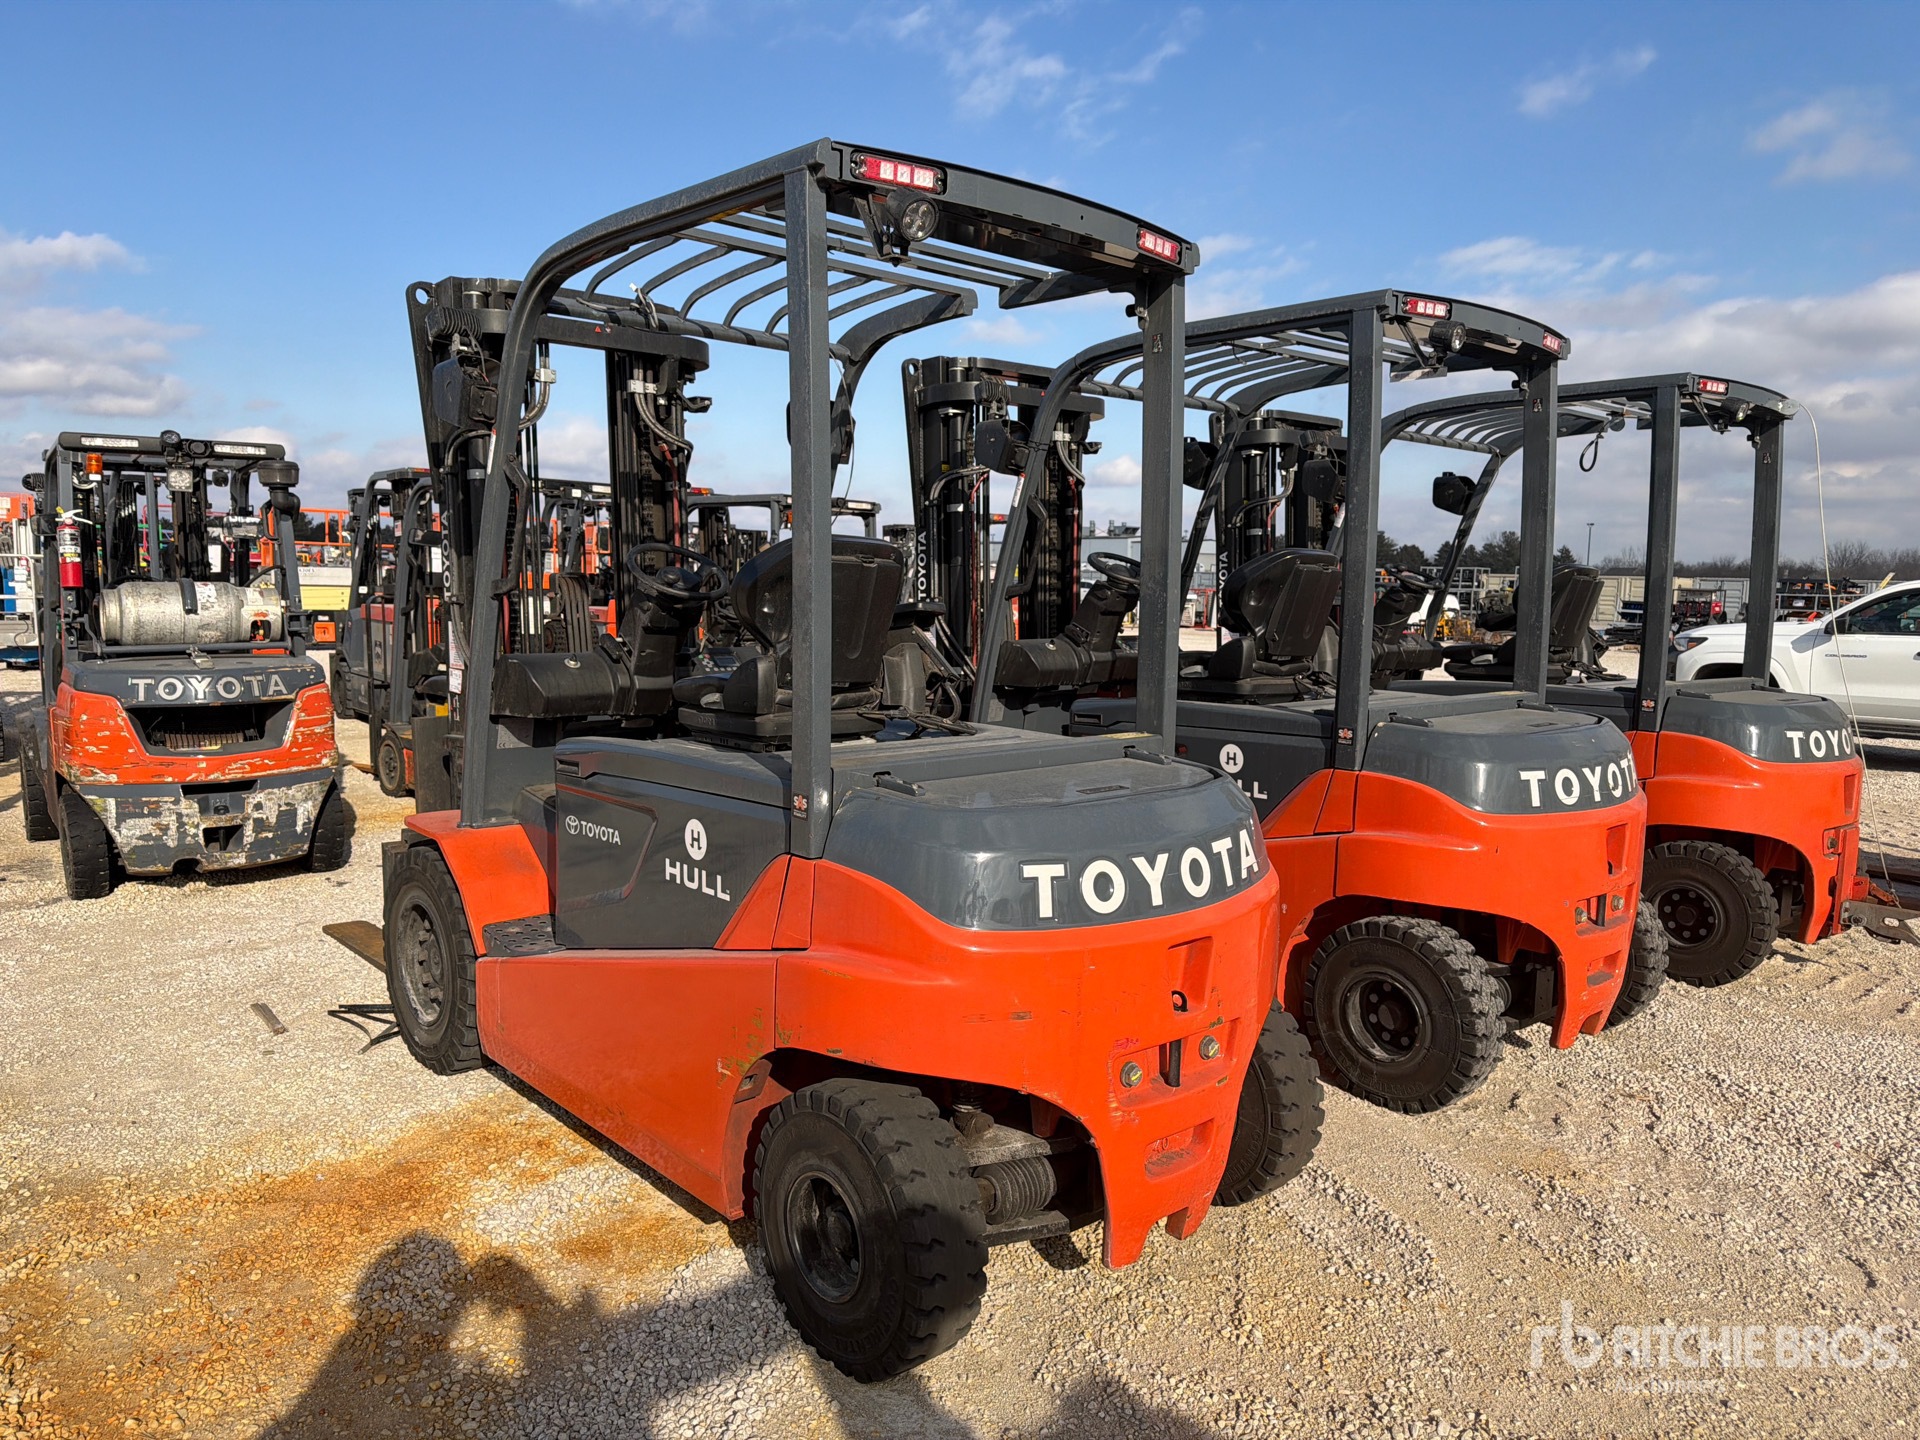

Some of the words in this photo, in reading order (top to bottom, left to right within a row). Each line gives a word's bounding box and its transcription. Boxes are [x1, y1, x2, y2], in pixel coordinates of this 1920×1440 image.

[441, 510, 452, 602] TOYOTA
[917, 531, 927, 601] TOYOTA
[129, 674, 289, 702] TOYOTA
[1786, 727, 1852, 759] TOYO
[580, 820, 622, 846] TOYOTA
[665, 857, 731, 902] HULL
[1022, 828, 1259, 919] TOYOTA
